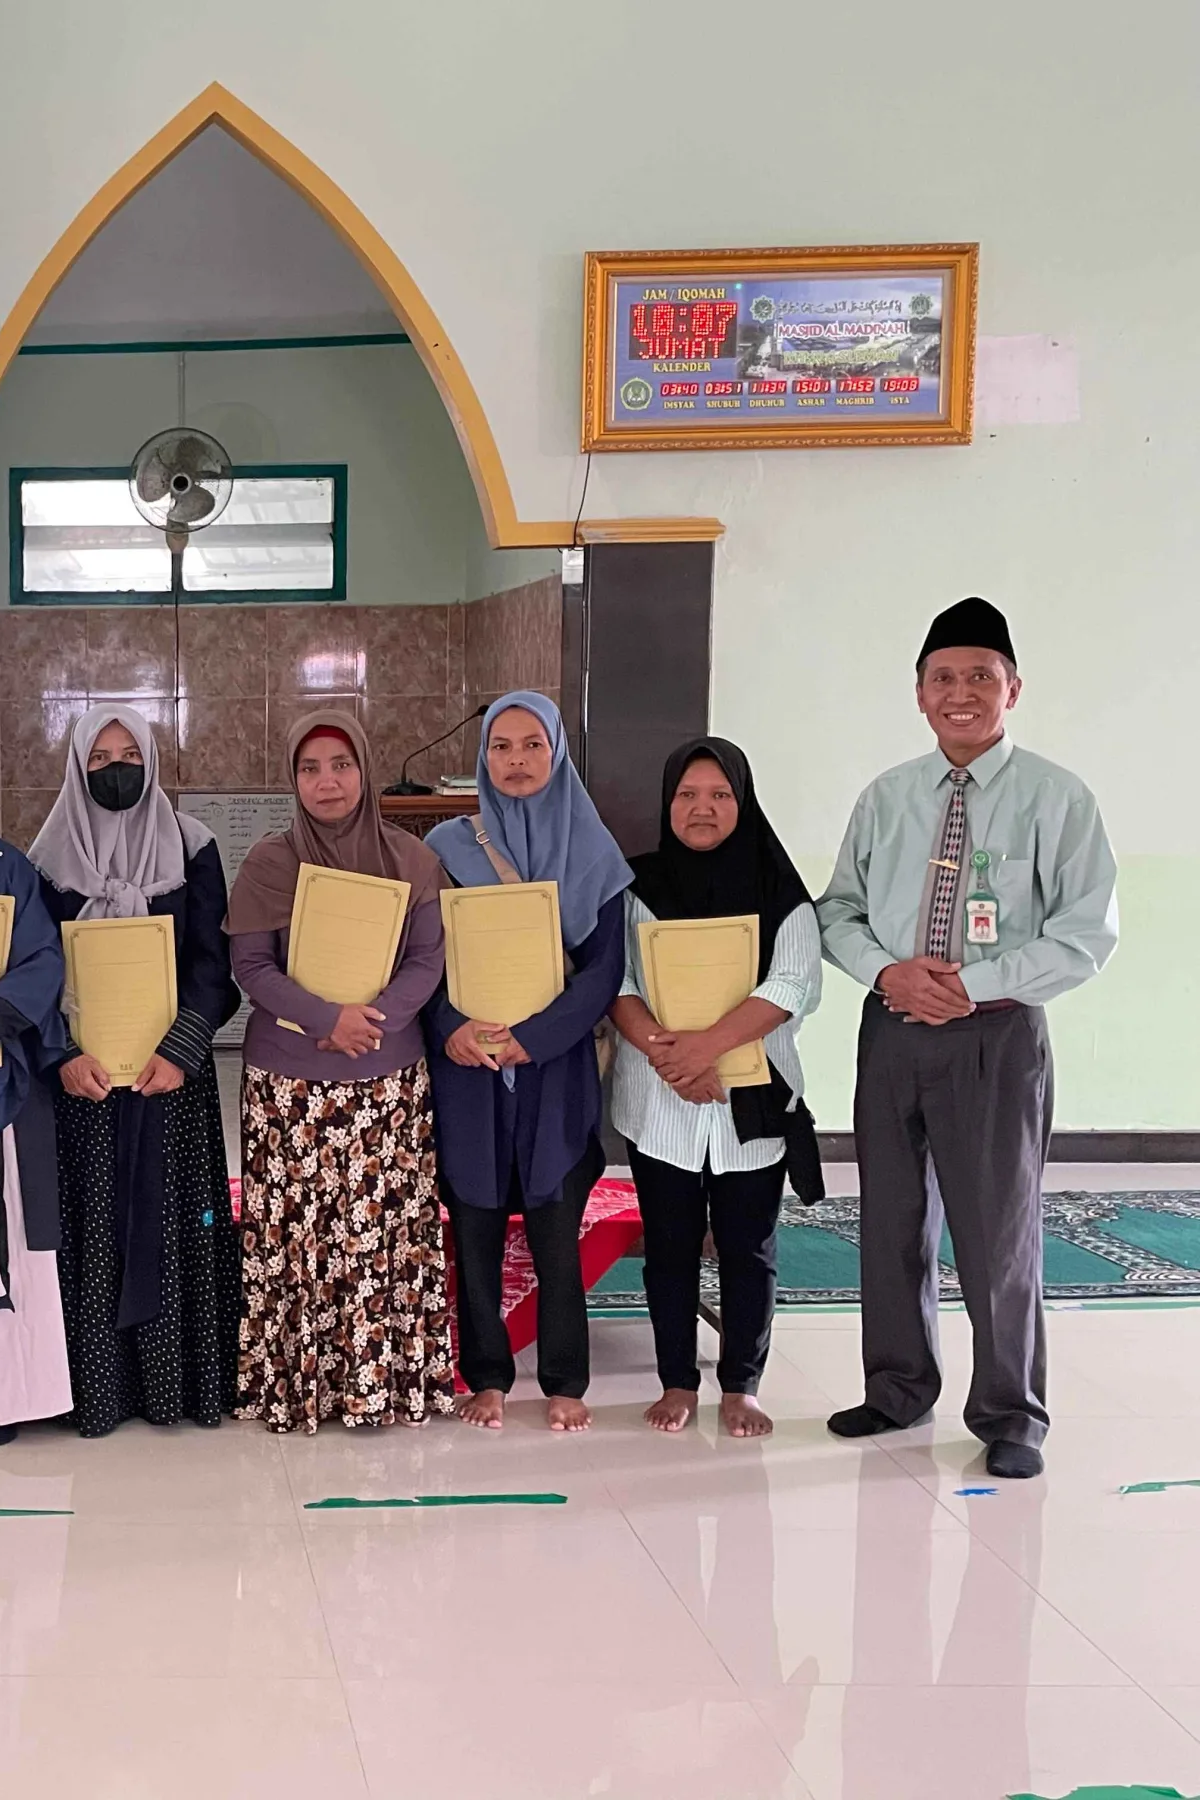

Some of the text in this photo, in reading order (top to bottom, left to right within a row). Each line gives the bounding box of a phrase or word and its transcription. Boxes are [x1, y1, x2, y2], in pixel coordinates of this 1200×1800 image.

[642, 288, 667, 301] JAM
[677, 287, 726, 302] IQOMAH
[633, 303, 737, 336] 10:07
[778, 321, 906, 339] MASJID AL MADINAH
[638, 337, 726, 359] JUMAT
[653, 361, 711, 373] KALENDER
[661, 383, 698, 395] 03:40
